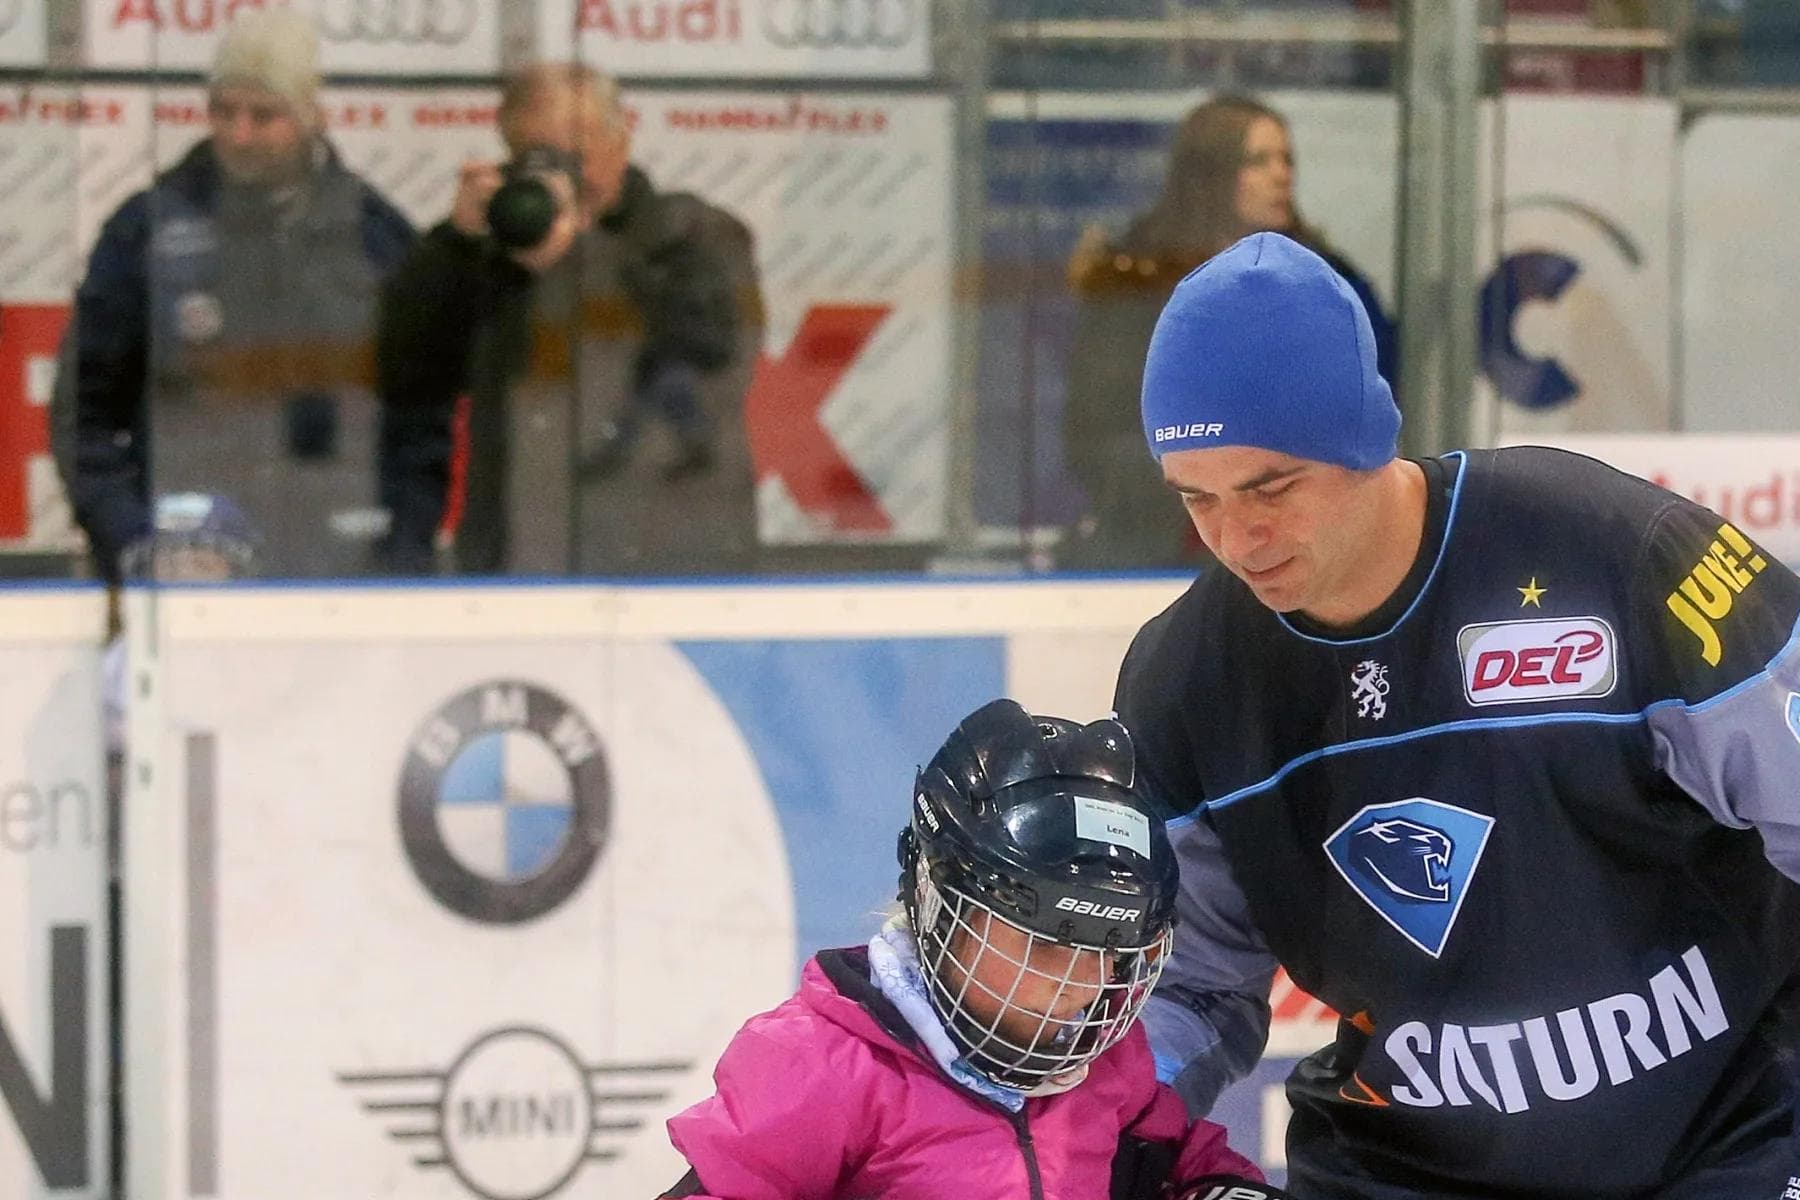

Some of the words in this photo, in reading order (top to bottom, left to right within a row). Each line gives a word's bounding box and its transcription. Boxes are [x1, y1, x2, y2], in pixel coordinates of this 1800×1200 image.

[578, 0, 743, 42] Audi
[1155, 423, 1223, 442] BAUER
[1472, 640, 1590, 692] DEL
[417, 688, 597, 768] BMW
[1107, 824, 1130, 838] Lena
[1055, 896, 1141, 924] BAUER
[1384, 945, 1731, 1113] SATURN
[457, 1091, 579, 1141] MINI
